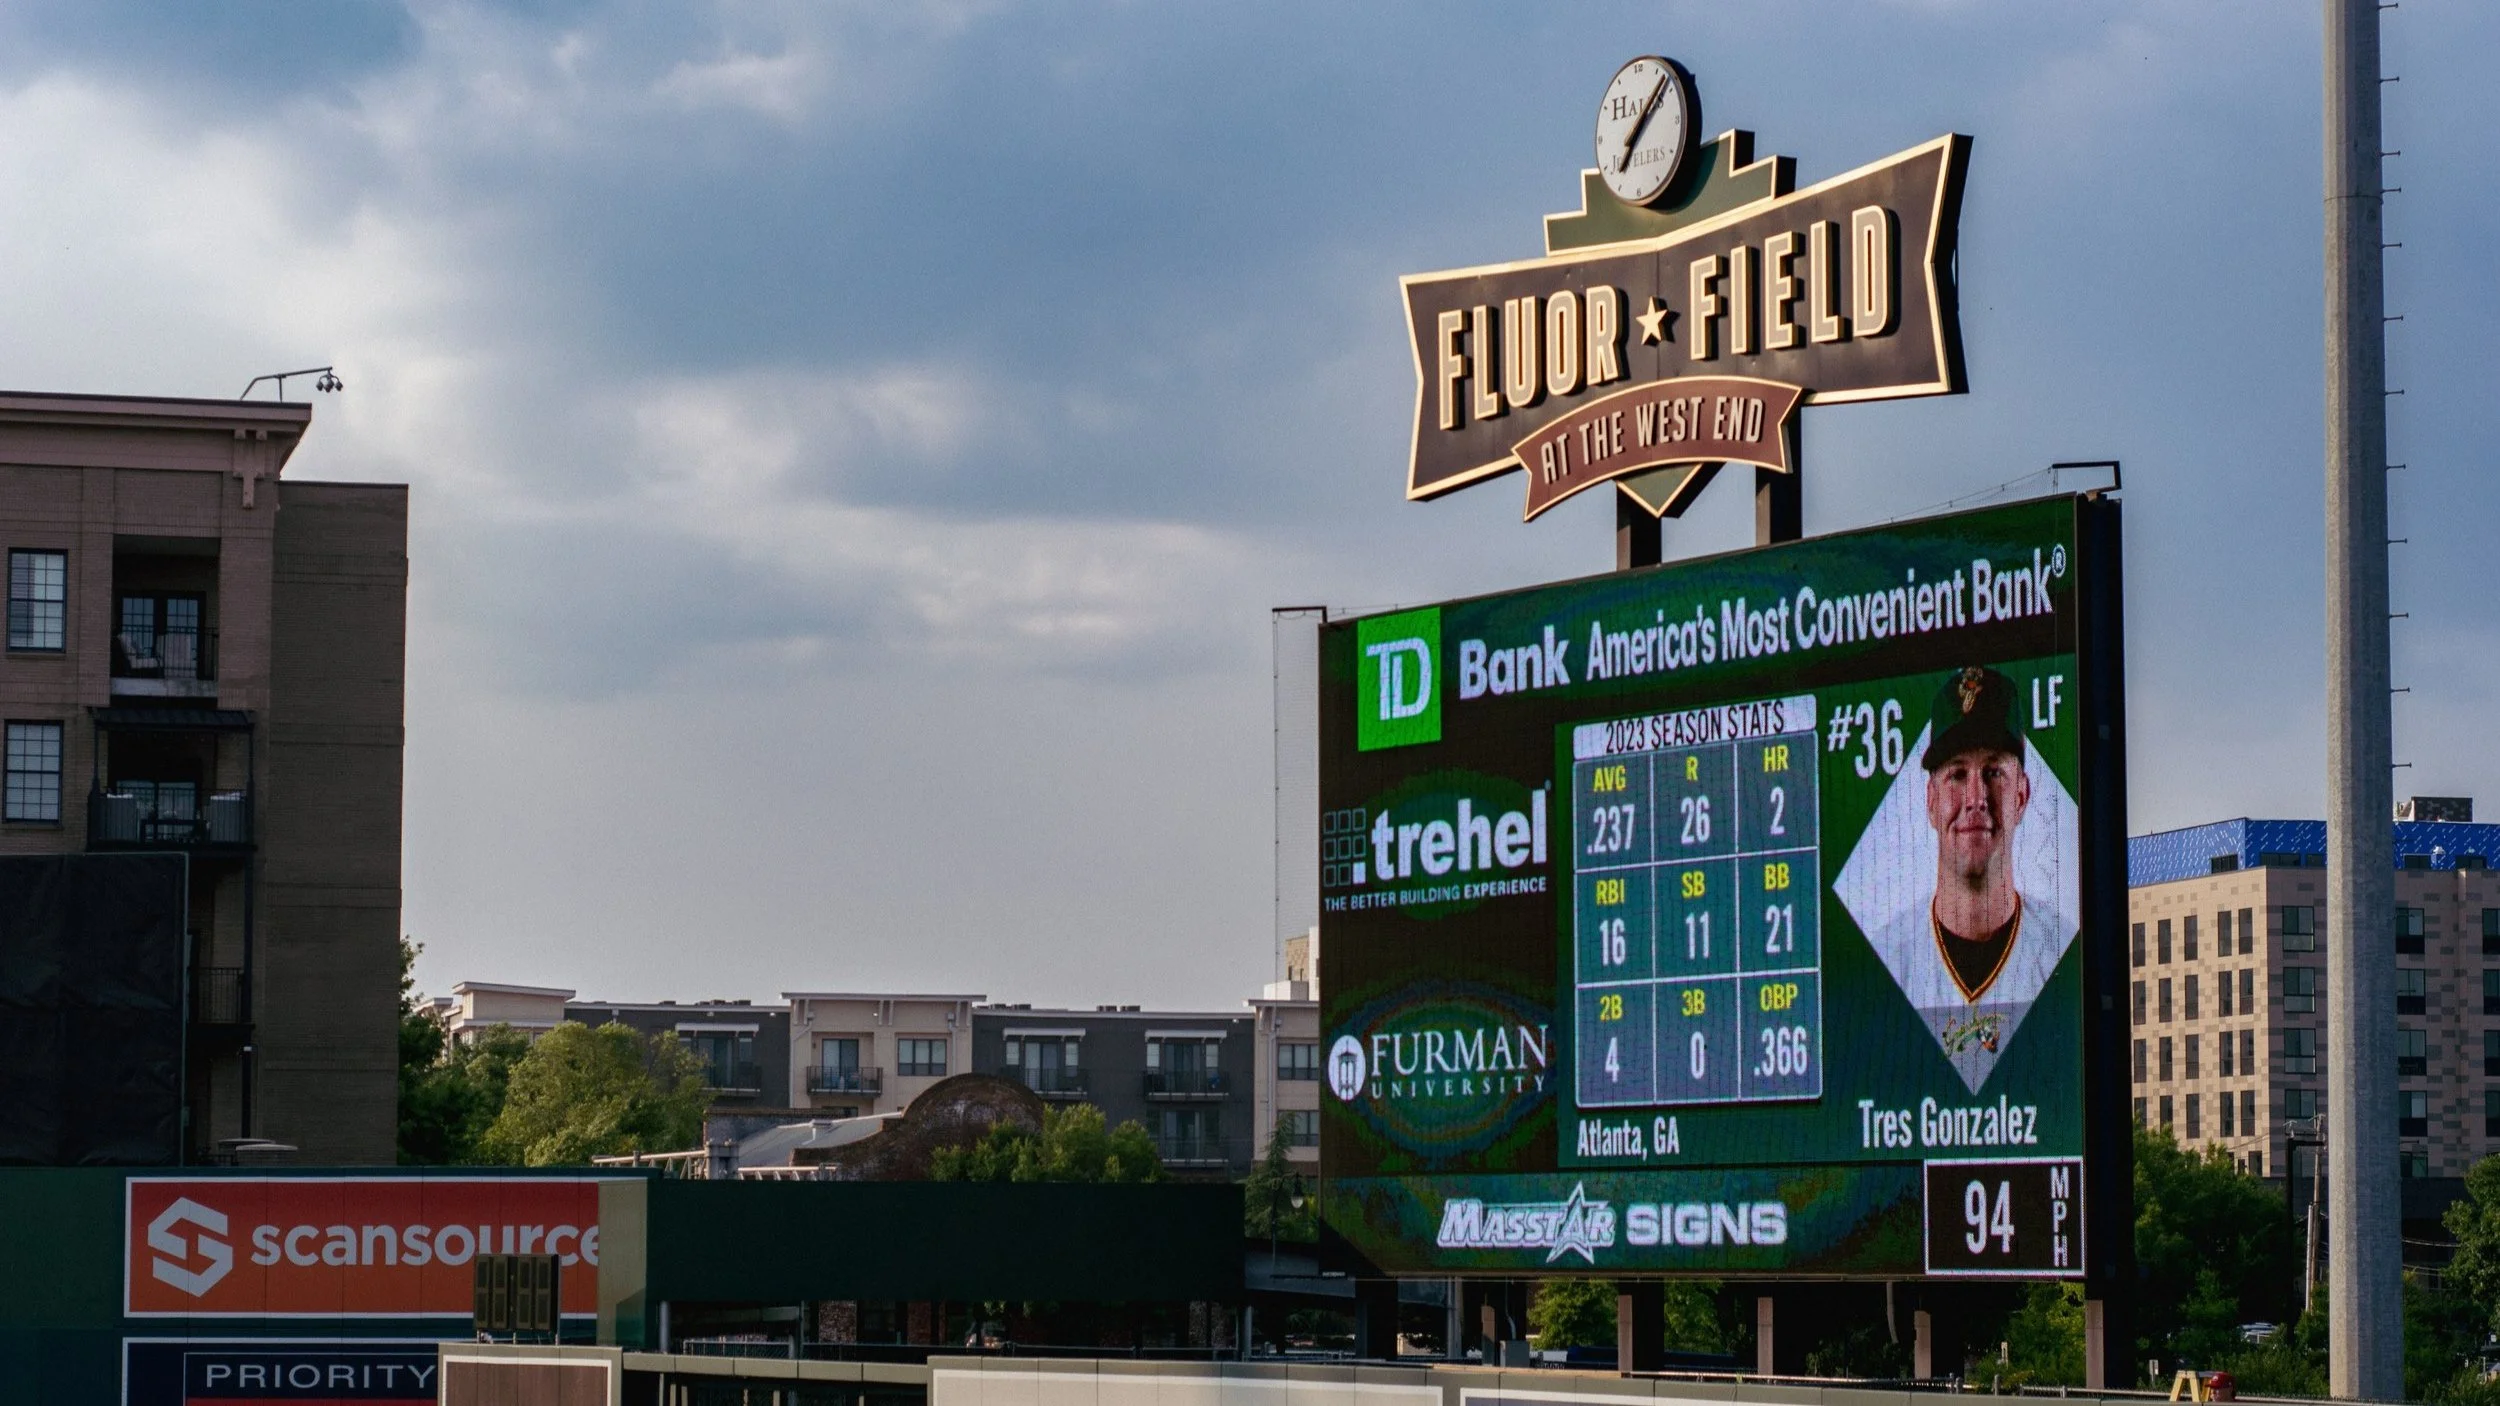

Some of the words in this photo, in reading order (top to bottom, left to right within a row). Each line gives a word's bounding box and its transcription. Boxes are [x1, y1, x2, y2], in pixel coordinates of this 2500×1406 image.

[1634, 63, 1644, 74] 12
[1610, 146, 1666, 175] JEELERS
[1438, 284, 1624, 430] FLUOR
[1689, 205, 1889, 360] FIELD
[1541, 431, 1570, 484] AT
[1579, 409, 1624, 462] THE
[1635, 396, 1702, 448] WEST
[1713, 396, 1765, 443] END
[1585, 608, 1717, 682] America's
[1721, 597, 1790, 660] Most
[1794, 567, 1967, 646] Convenient
[1366, 638, 1433, 722] TD
[1459, 625, 1570, 700] Bank
[2032, 674, 2063, 730] LF
[1606, 719, 1646, 754] 2023
[1651, 708, 1723, 748] SEASON
[1727, 700, 1785, 739] STATS
[1827, 698, 1905, 780] #36
[1593, 765, 1627, 792] AVG
[1686, 756, 1698, 781] R
[1764, 745, 1789, 773] HR
[1586, 804, 1635, 855] .237
[1680, 795, 1711, 845] 26
[1770, 786, 1785, 836] 2
[1324, 897, 1347, 913] THE
[1351, 892, 1396, 910] BETTER
[1400, 887, 1460, 906] BUILDING
[1464, 876, 1547, 899] EXPERIENCE
[1596, 878, 1625, 905] RBI
[1682, 871, 1706, 898] SB
[1765, 863, 1790, 890] BB
[1599, 918, 1626, 966] 16
[1685, 911, 1710, 960] 11
[1766, 903, 1793, 955] 21
[1600, 995, 1623, 1021] 2B
[1682, 989, 1706, 1016] 3B
[1760, 983, 1798, 1012] OBP
[1371, 1024, 1548, 1077] FURMAN
[1605, 1036, 1620, 1083] 4
[1690, 1031, 1705, 1080] 0
[1753, 1024, 1807, 1077] .366
[1371, 1074, 1546, 1099] UNIVERSITY
[1577, 1118, 1647, 1162] Atlanta,
[1654, 1115, 1680, 1156] GA
[1858, 1098, 1912, 1150] Tres
[1921, 1095, 2038, 1147] Gonzalez
[1626, 1202, 1788, 1245] SIGNS
[1965, 1179, 2015, 1256] 94
[205, 1363, 436, 1389] PRIORITY
